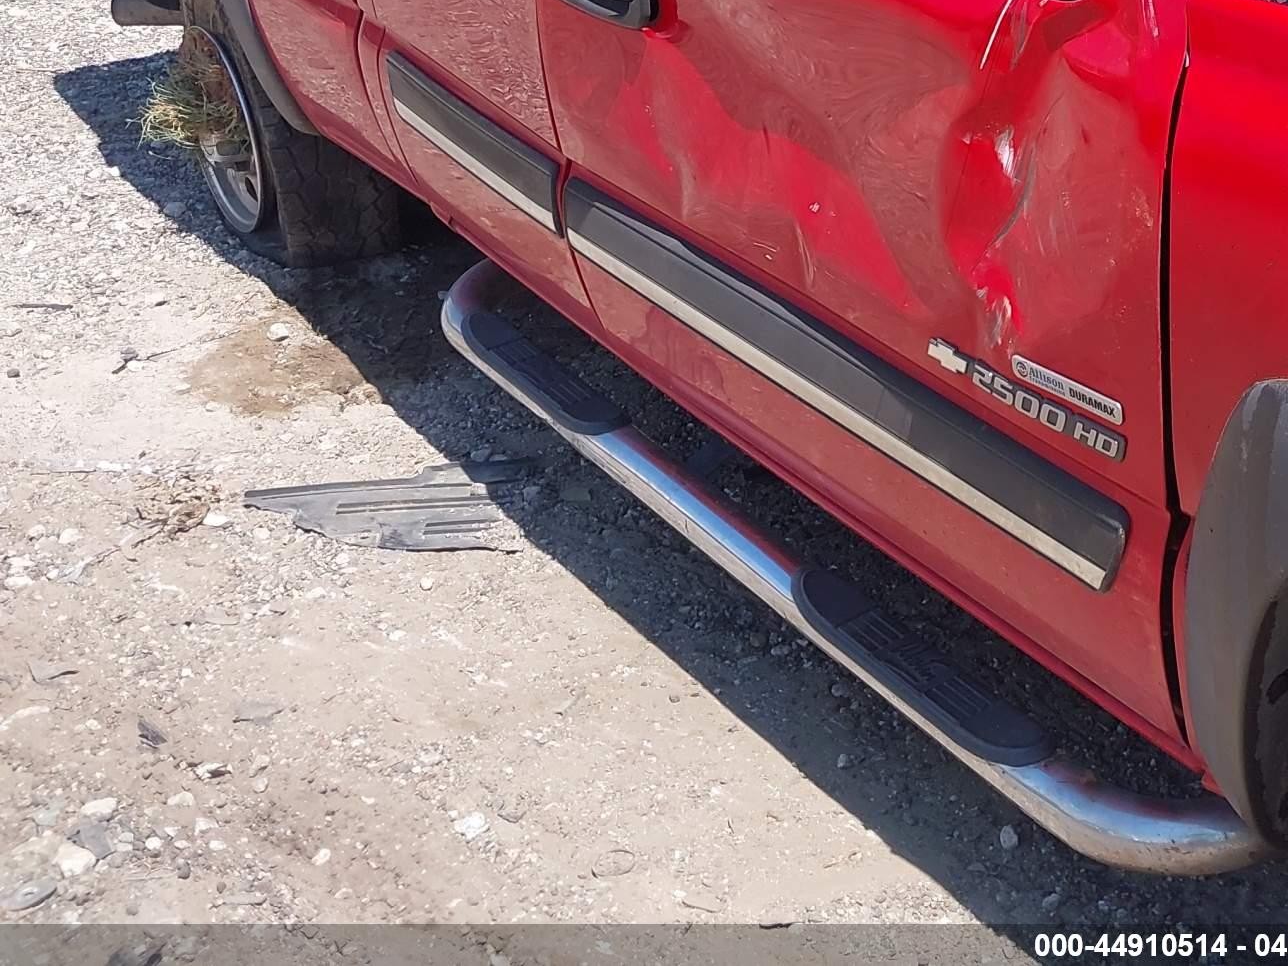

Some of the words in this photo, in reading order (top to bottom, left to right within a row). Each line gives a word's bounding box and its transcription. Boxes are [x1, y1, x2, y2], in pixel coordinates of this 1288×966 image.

[1029, 366, 1065, 391] Allison
[972, 363, 1067, 433] 2500
[1073, 421, 1119, 459] HD
[1068, 387, 1116, 419] DURAMAX
